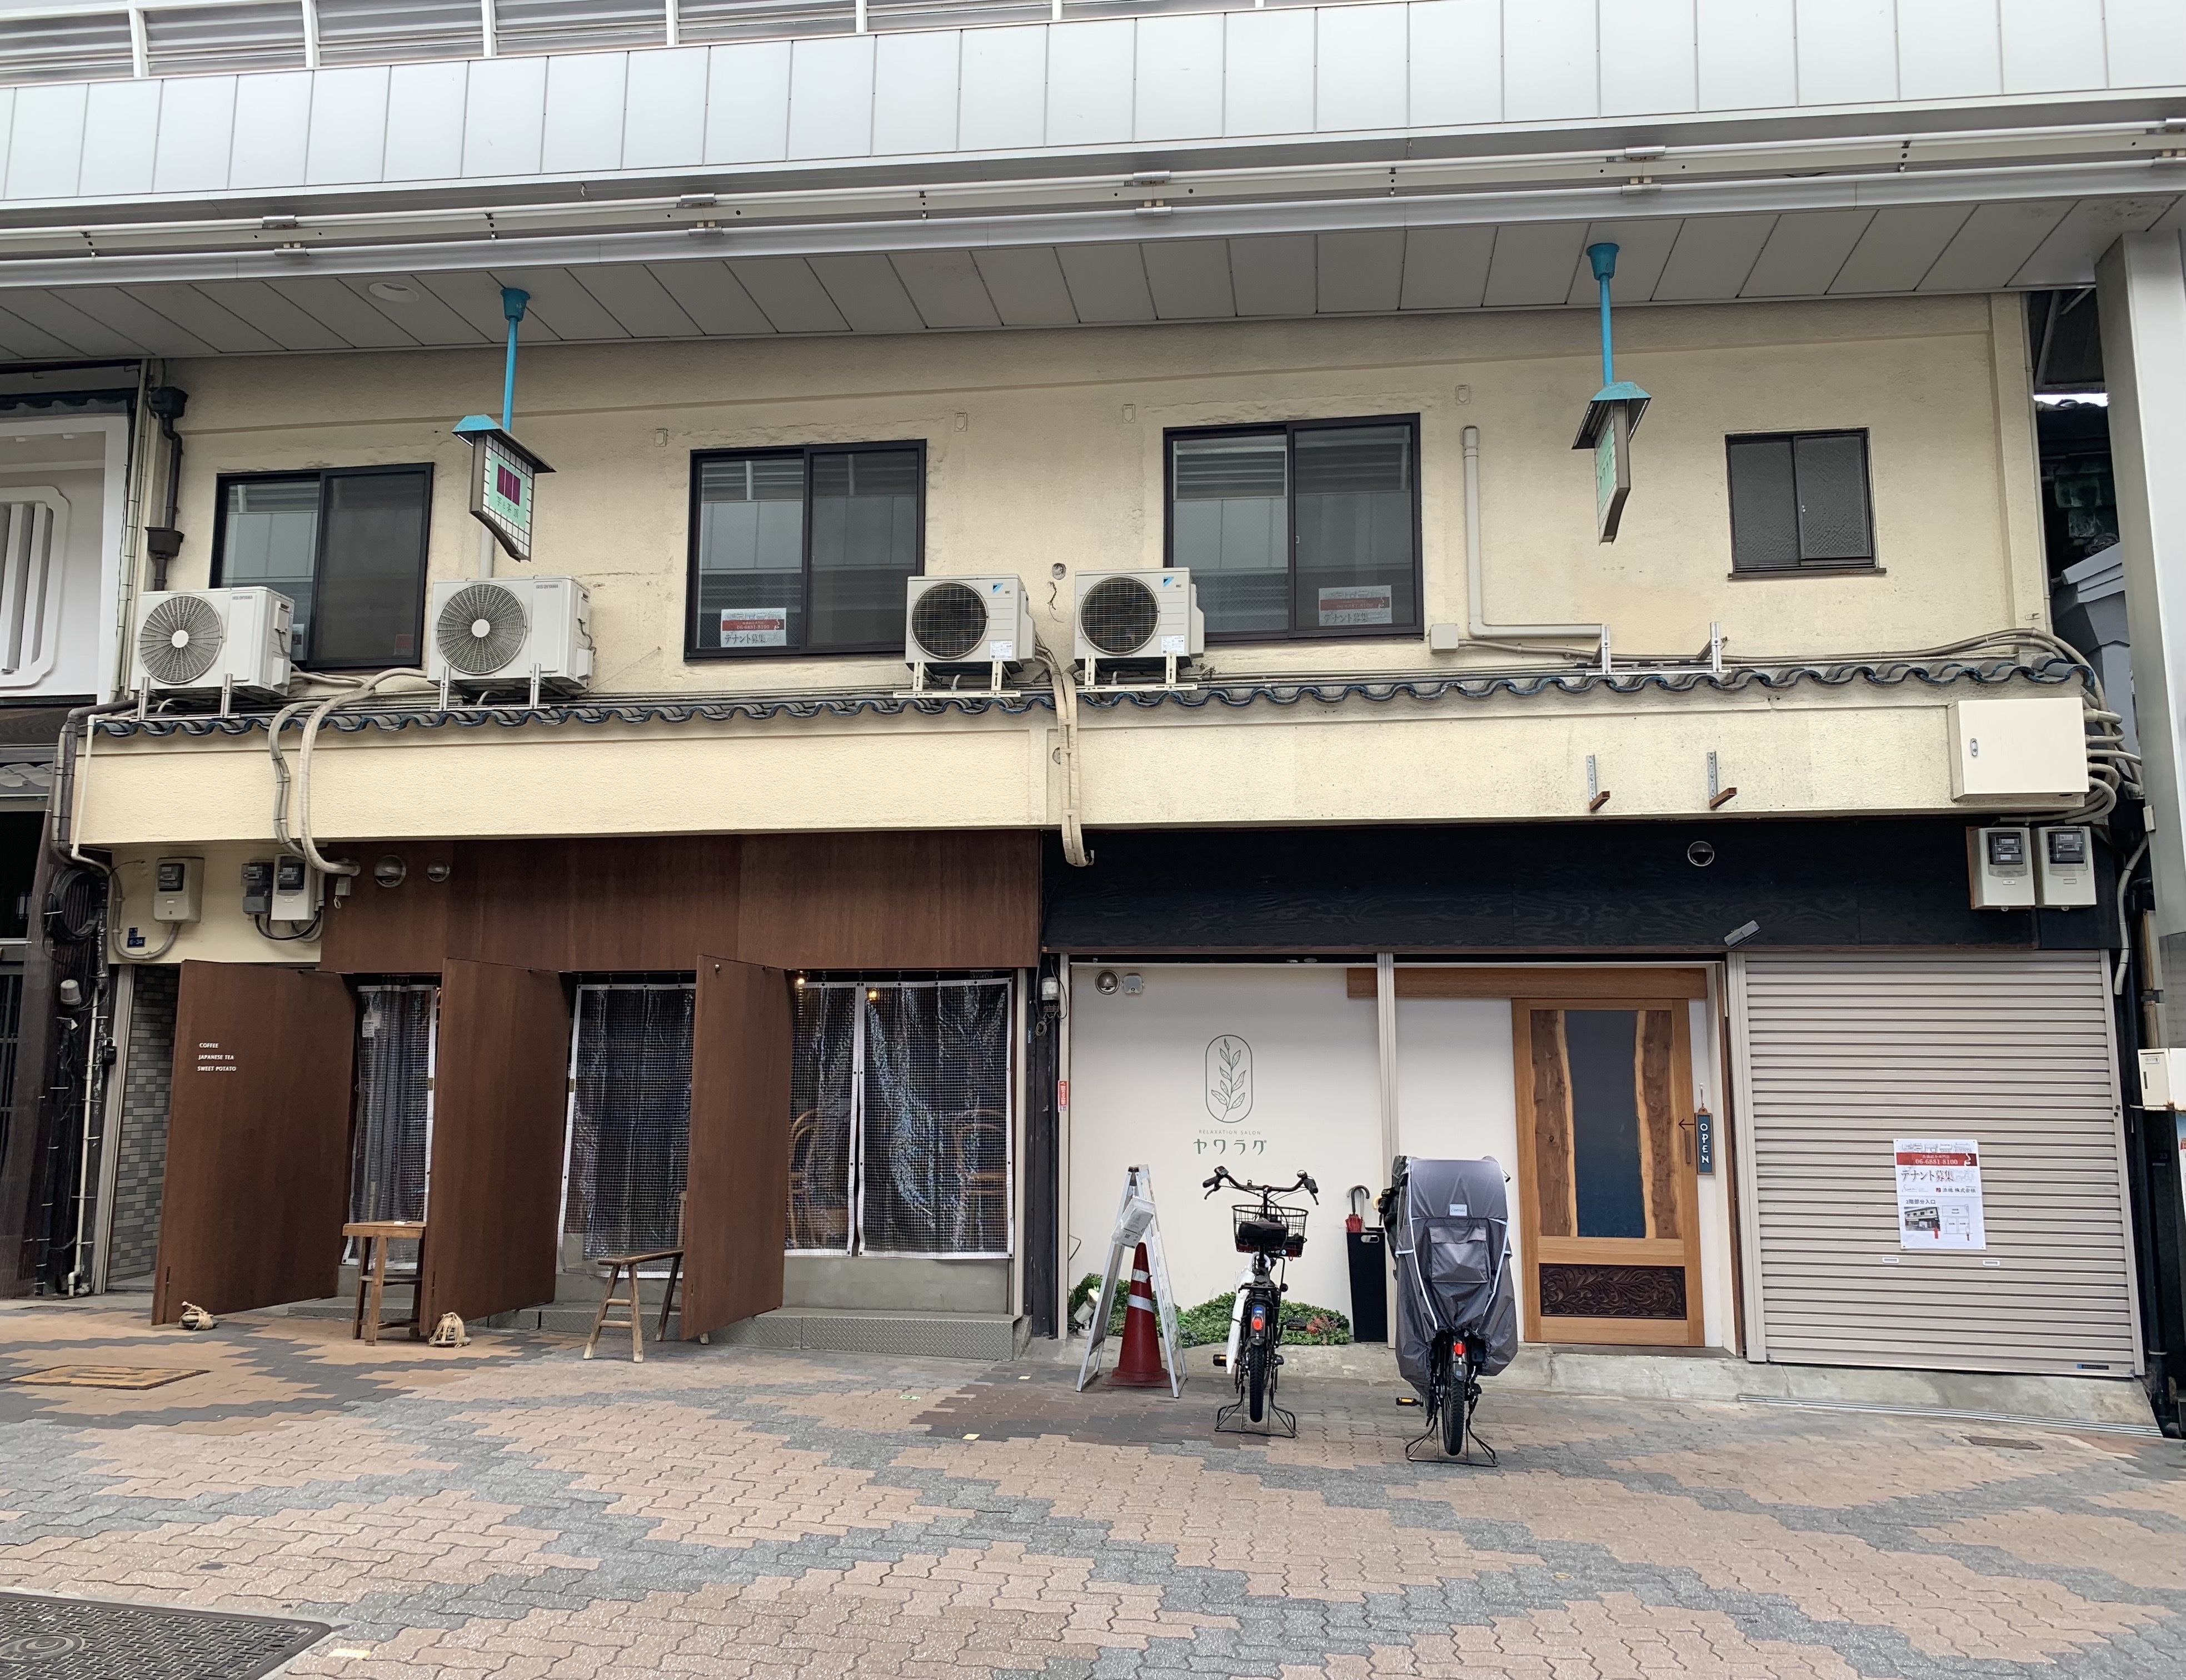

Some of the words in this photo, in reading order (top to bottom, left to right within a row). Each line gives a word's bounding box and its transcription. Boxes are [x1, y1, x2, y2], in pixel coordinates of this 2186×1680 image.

[1193, 1138, 1267, 1156] ヤワラグ
[1700, 1123, 1709, 1164] OPEN
[1901, 1169, 1954, 1182] テナント募集
